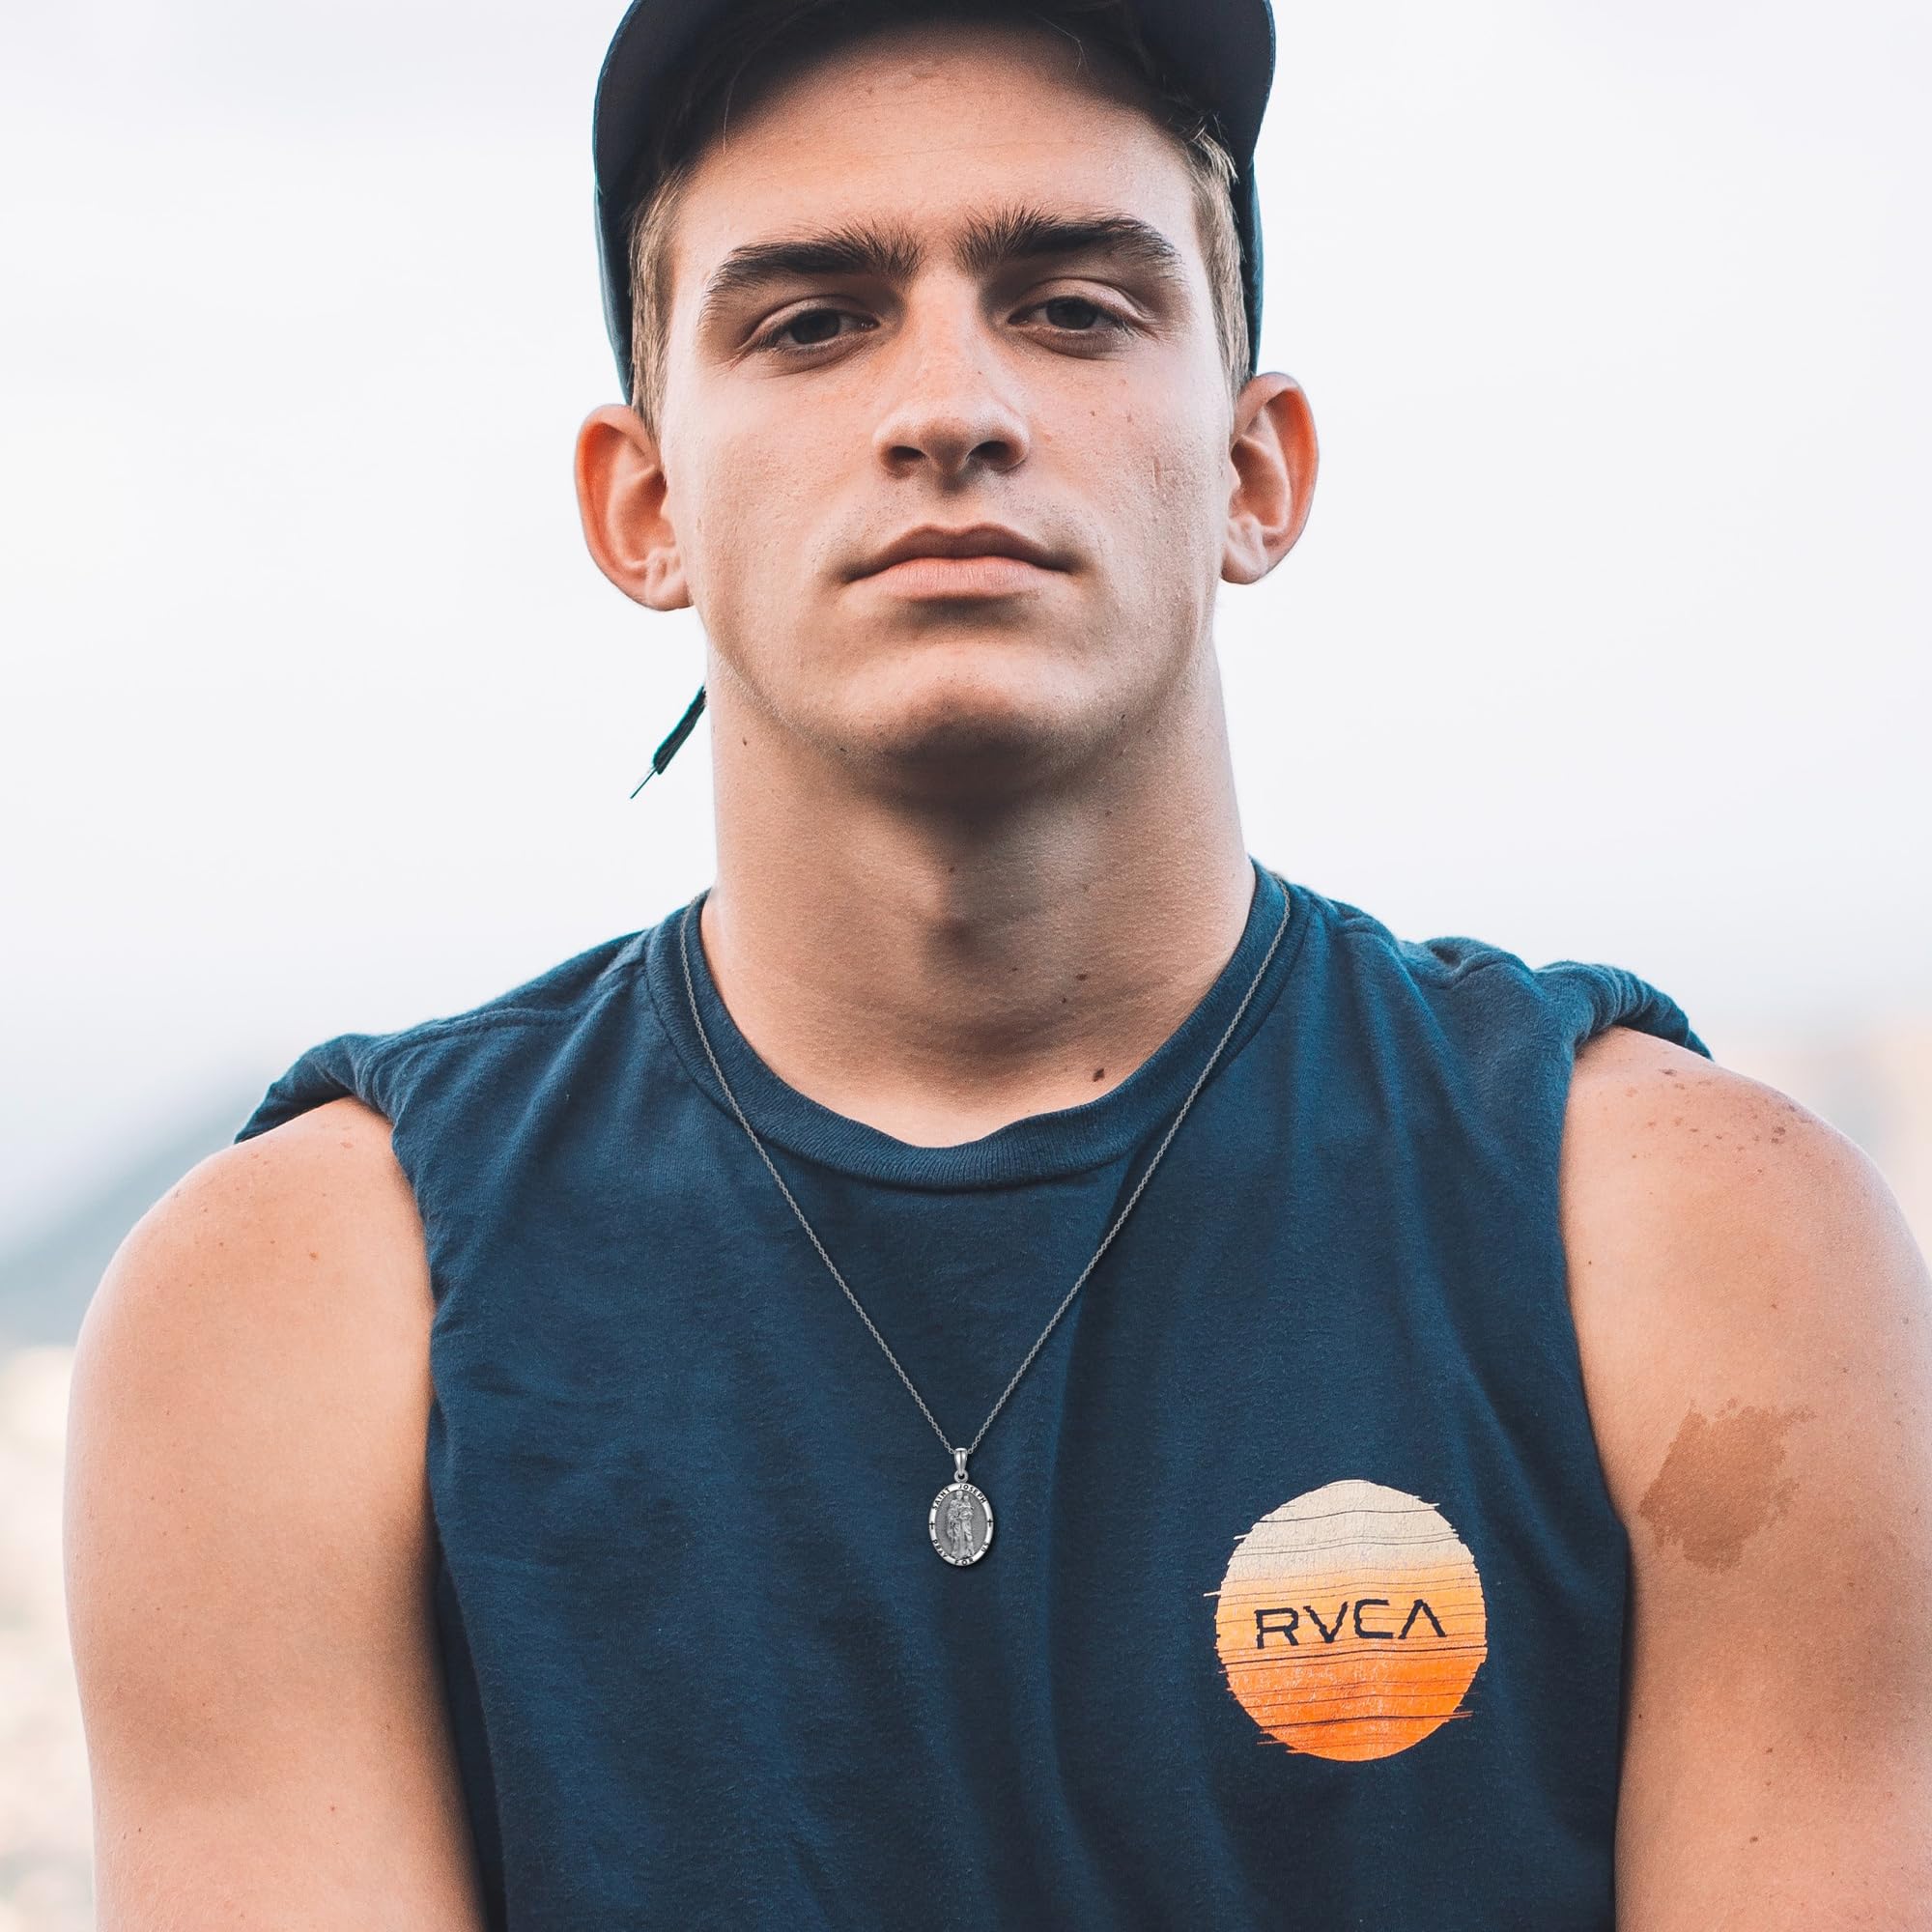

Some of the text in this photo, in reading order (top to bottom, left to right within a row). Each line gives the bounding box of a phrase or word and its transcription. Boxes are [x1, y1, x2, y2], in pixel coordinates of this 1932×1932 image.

[932, 1484, 986, 1510] SAINT JOSEPH
[932, 1539, 947, 1558] PRAY
[981, 1543, 989, 1552] US
[1254, 1599, 1448, 1649] RVCA
